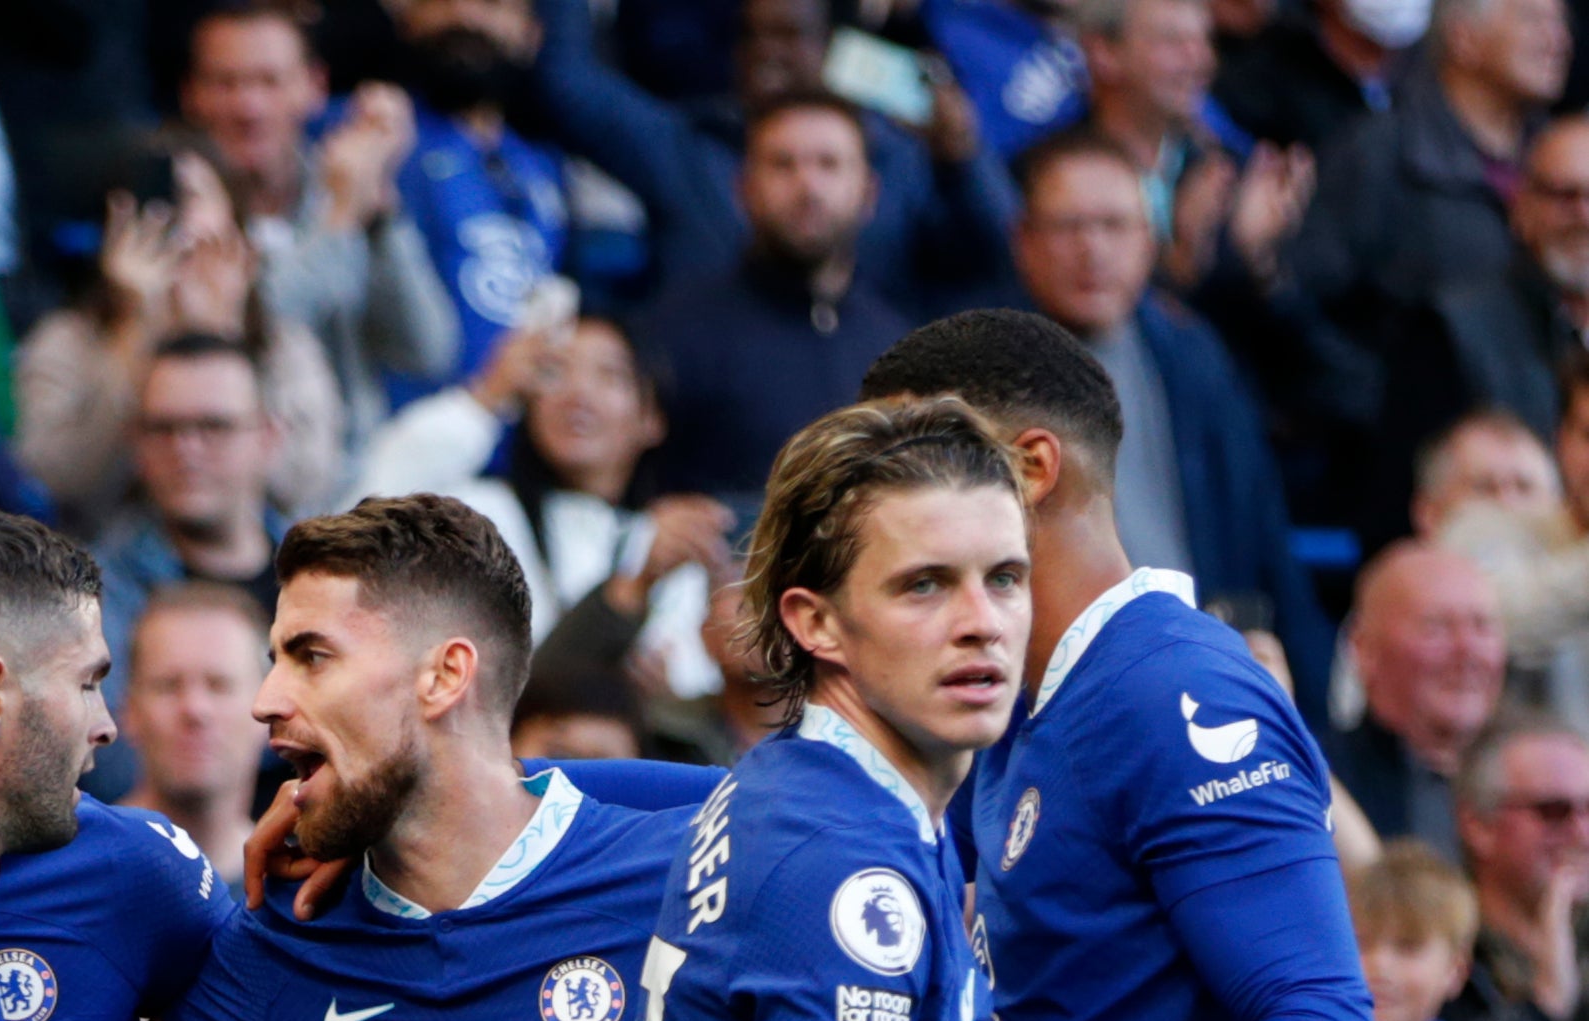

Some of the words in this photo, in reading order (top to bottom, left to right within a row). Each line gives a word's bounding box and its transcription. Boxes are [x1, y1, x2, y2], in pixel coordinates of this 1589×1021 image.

[1189, 760, 1291, 806] WhaleFin
[552, 959, 607, 981] CHELSEA
[837, 985, 872, 1008] No
